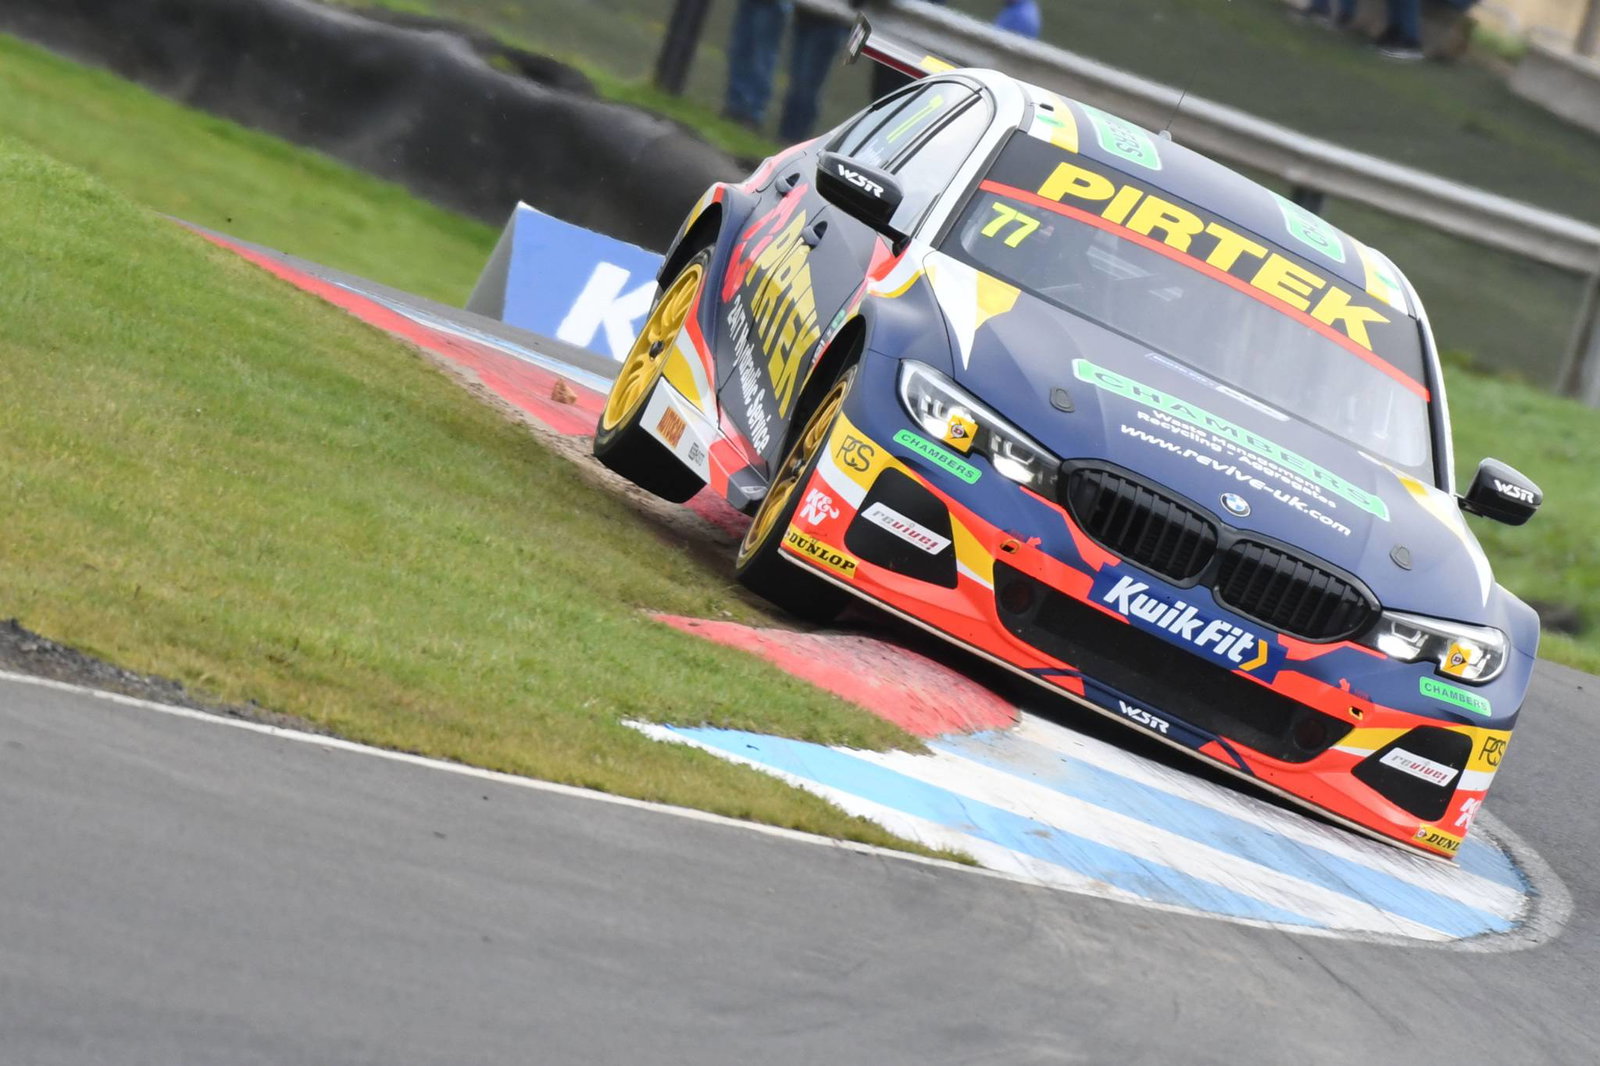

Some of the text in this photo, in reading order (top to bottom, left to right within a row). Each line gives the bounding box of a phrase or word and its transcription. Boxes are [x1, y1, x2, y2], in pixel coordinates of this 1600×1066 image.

[838, 163, 884, 198] WSR
[981, 201, 1041, 248] 77
[1037, 161, 1391, 351] PIRTEK
[745, 208, 821, 419] PIRTEK
[733, 321, 761, 405] Hydraulic
[746, 388, 772, 456] Service
[900, 433, 975, 479] CHAMBERS
[1094, 371, 1371, 505] CHAMBERS
[1152, 409, 1321, 493] Waste Management
[1120, 423, 1351, 536] www.revive-uk.com
[1136, 410, 1222, 452] Recycling
[1238, 455, 1337, 509] Aggregates
[1494, 479, 1535, 504] WSR
[789, 532, 856, 570] DUNLOP
[1119, 700, 1170, 734] WSR
[1423, 682, 1489, 712] CHAMBERS
